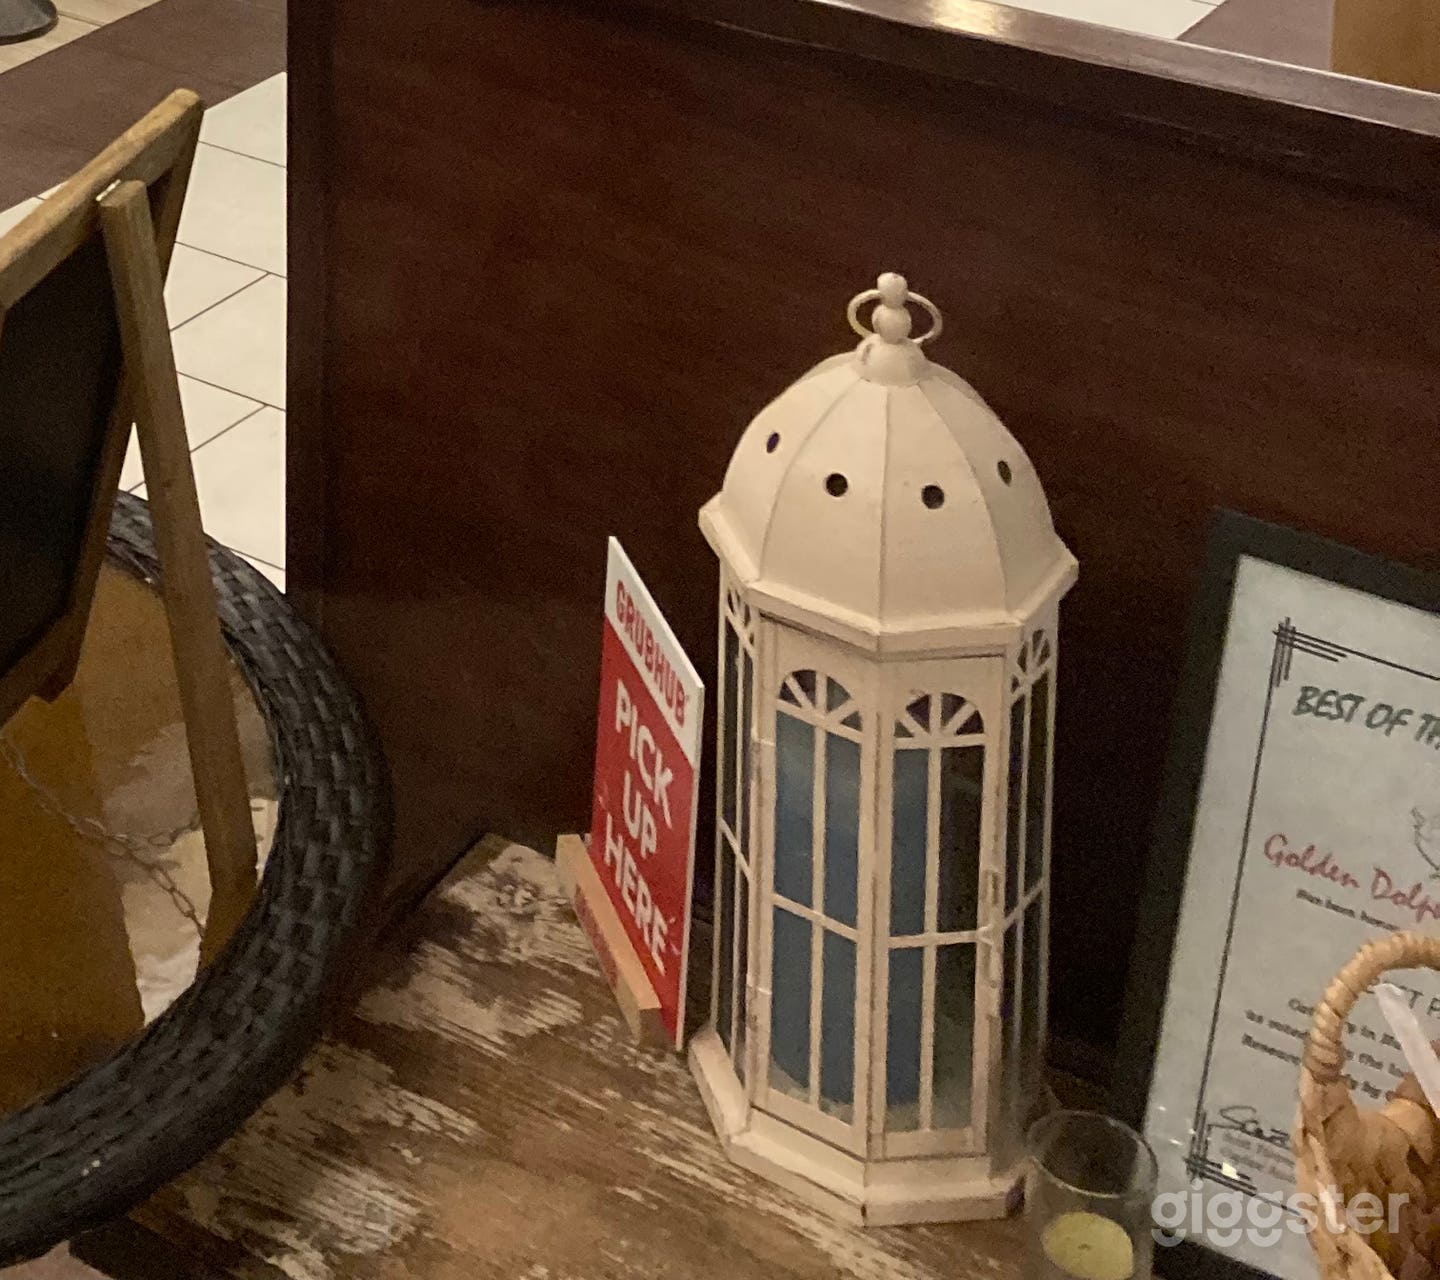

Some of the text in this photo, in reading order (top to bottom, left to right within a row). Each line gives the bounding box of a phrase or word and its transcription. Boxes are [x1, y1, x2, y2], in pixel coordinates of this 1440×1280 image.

[616, 579, 685, 728] GRUBHUB
[1292, 685, 1365, 723] BEST
[1365, 703, 1414, 736] OF
[616, 678, 673, 829] PICK
[623, 770, 658, 860] UP
[1263, 833, 1361, 889] Golden
[604, 812, 669, 977] HERE
